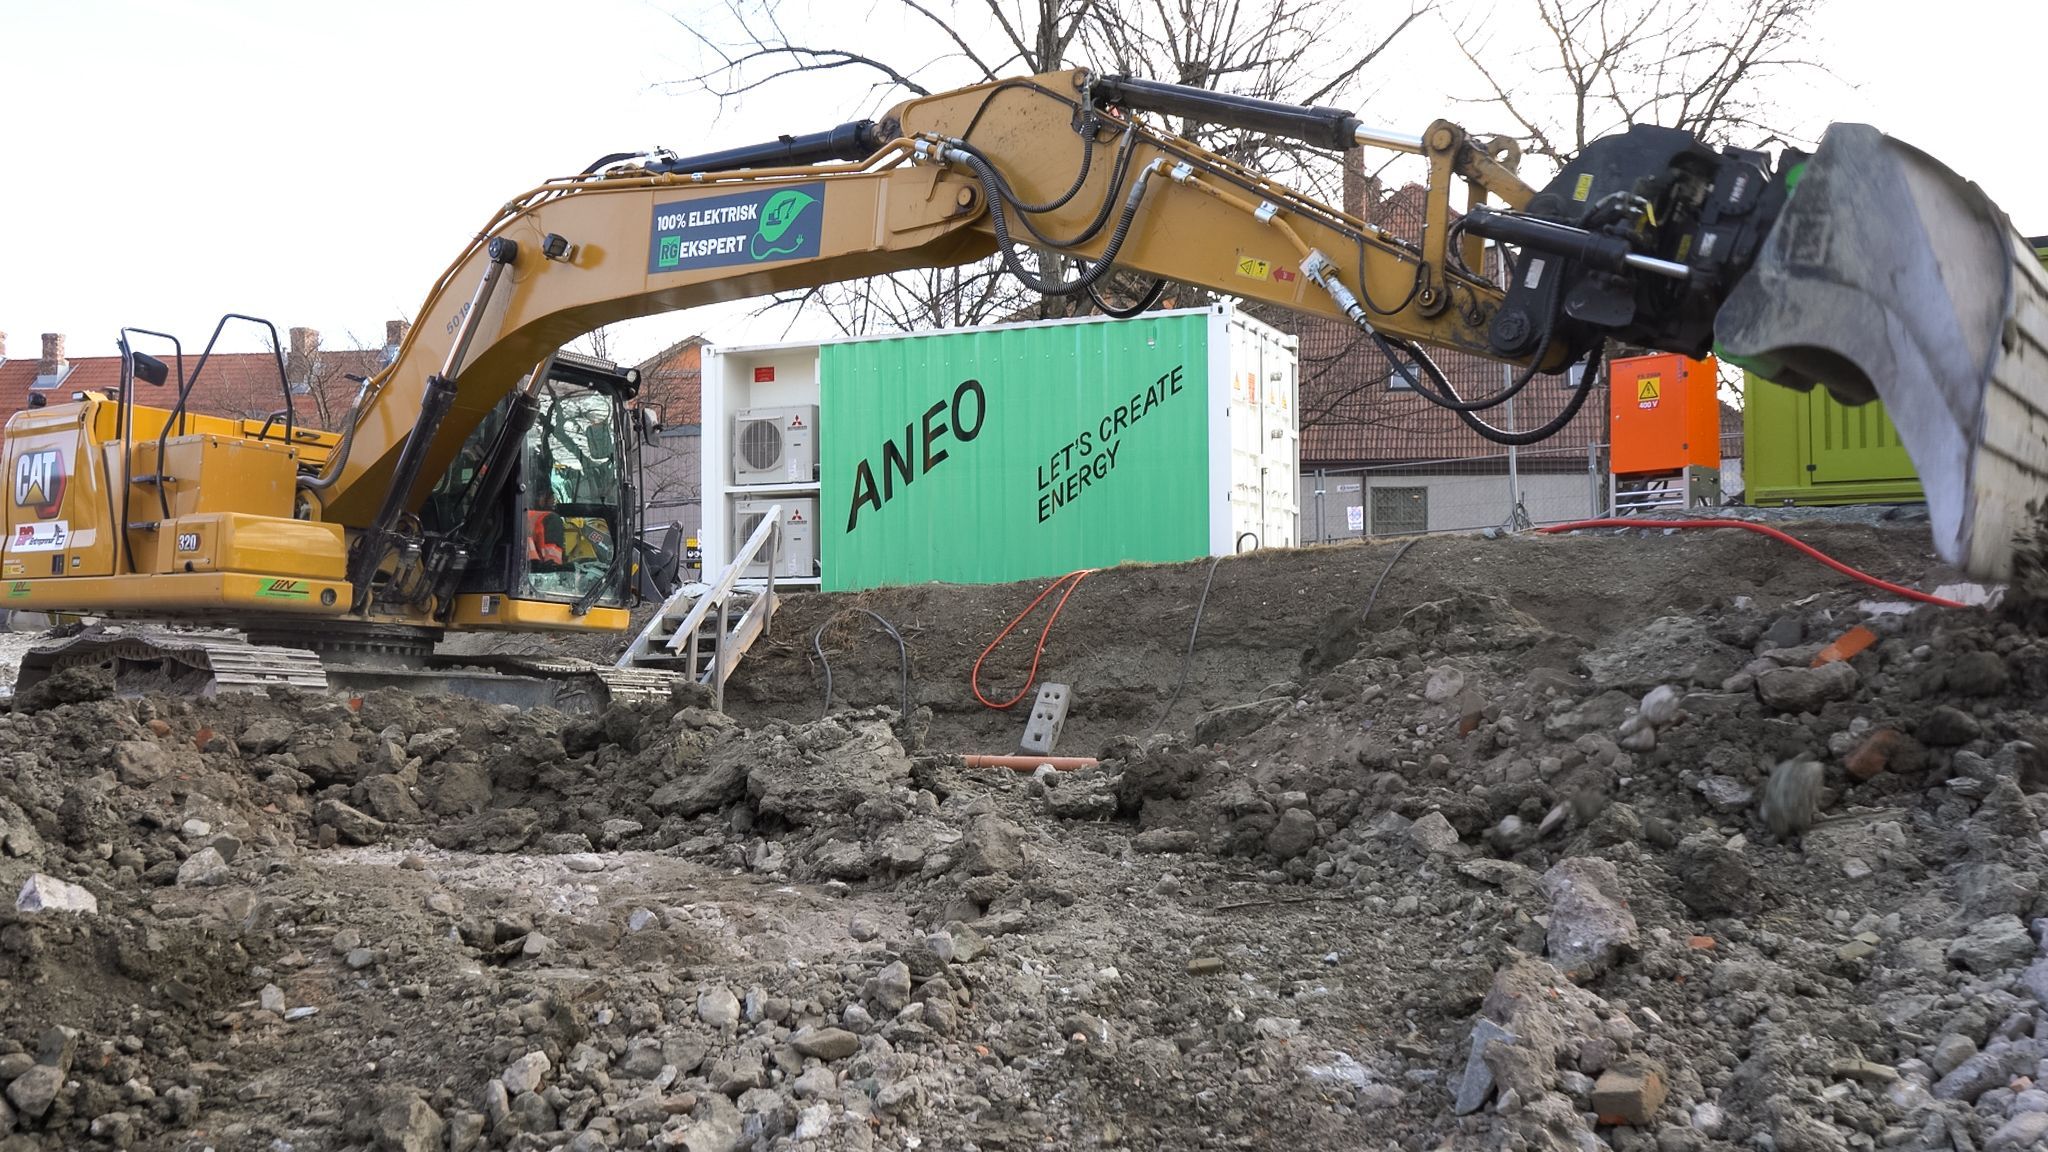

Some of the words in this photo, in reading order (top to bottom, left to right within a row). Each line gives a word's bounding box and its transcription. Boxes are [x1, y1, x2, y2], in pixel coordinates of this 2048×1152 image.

[657, 212, 687, 232] 100%
[688, 203, 758, 227] ELEKTRISK
[1037, 431, 1093, 491] LET'S
[1099, 365, 1184, 443] CREATE
[1652, 400, 1659, 408] V
[16, 451, 57, 505] CAT
[846, 379, 986, 534] ANEO
[1037, 440, 1121, 524] ENERGY
[178, 534, 197, 551] 320
